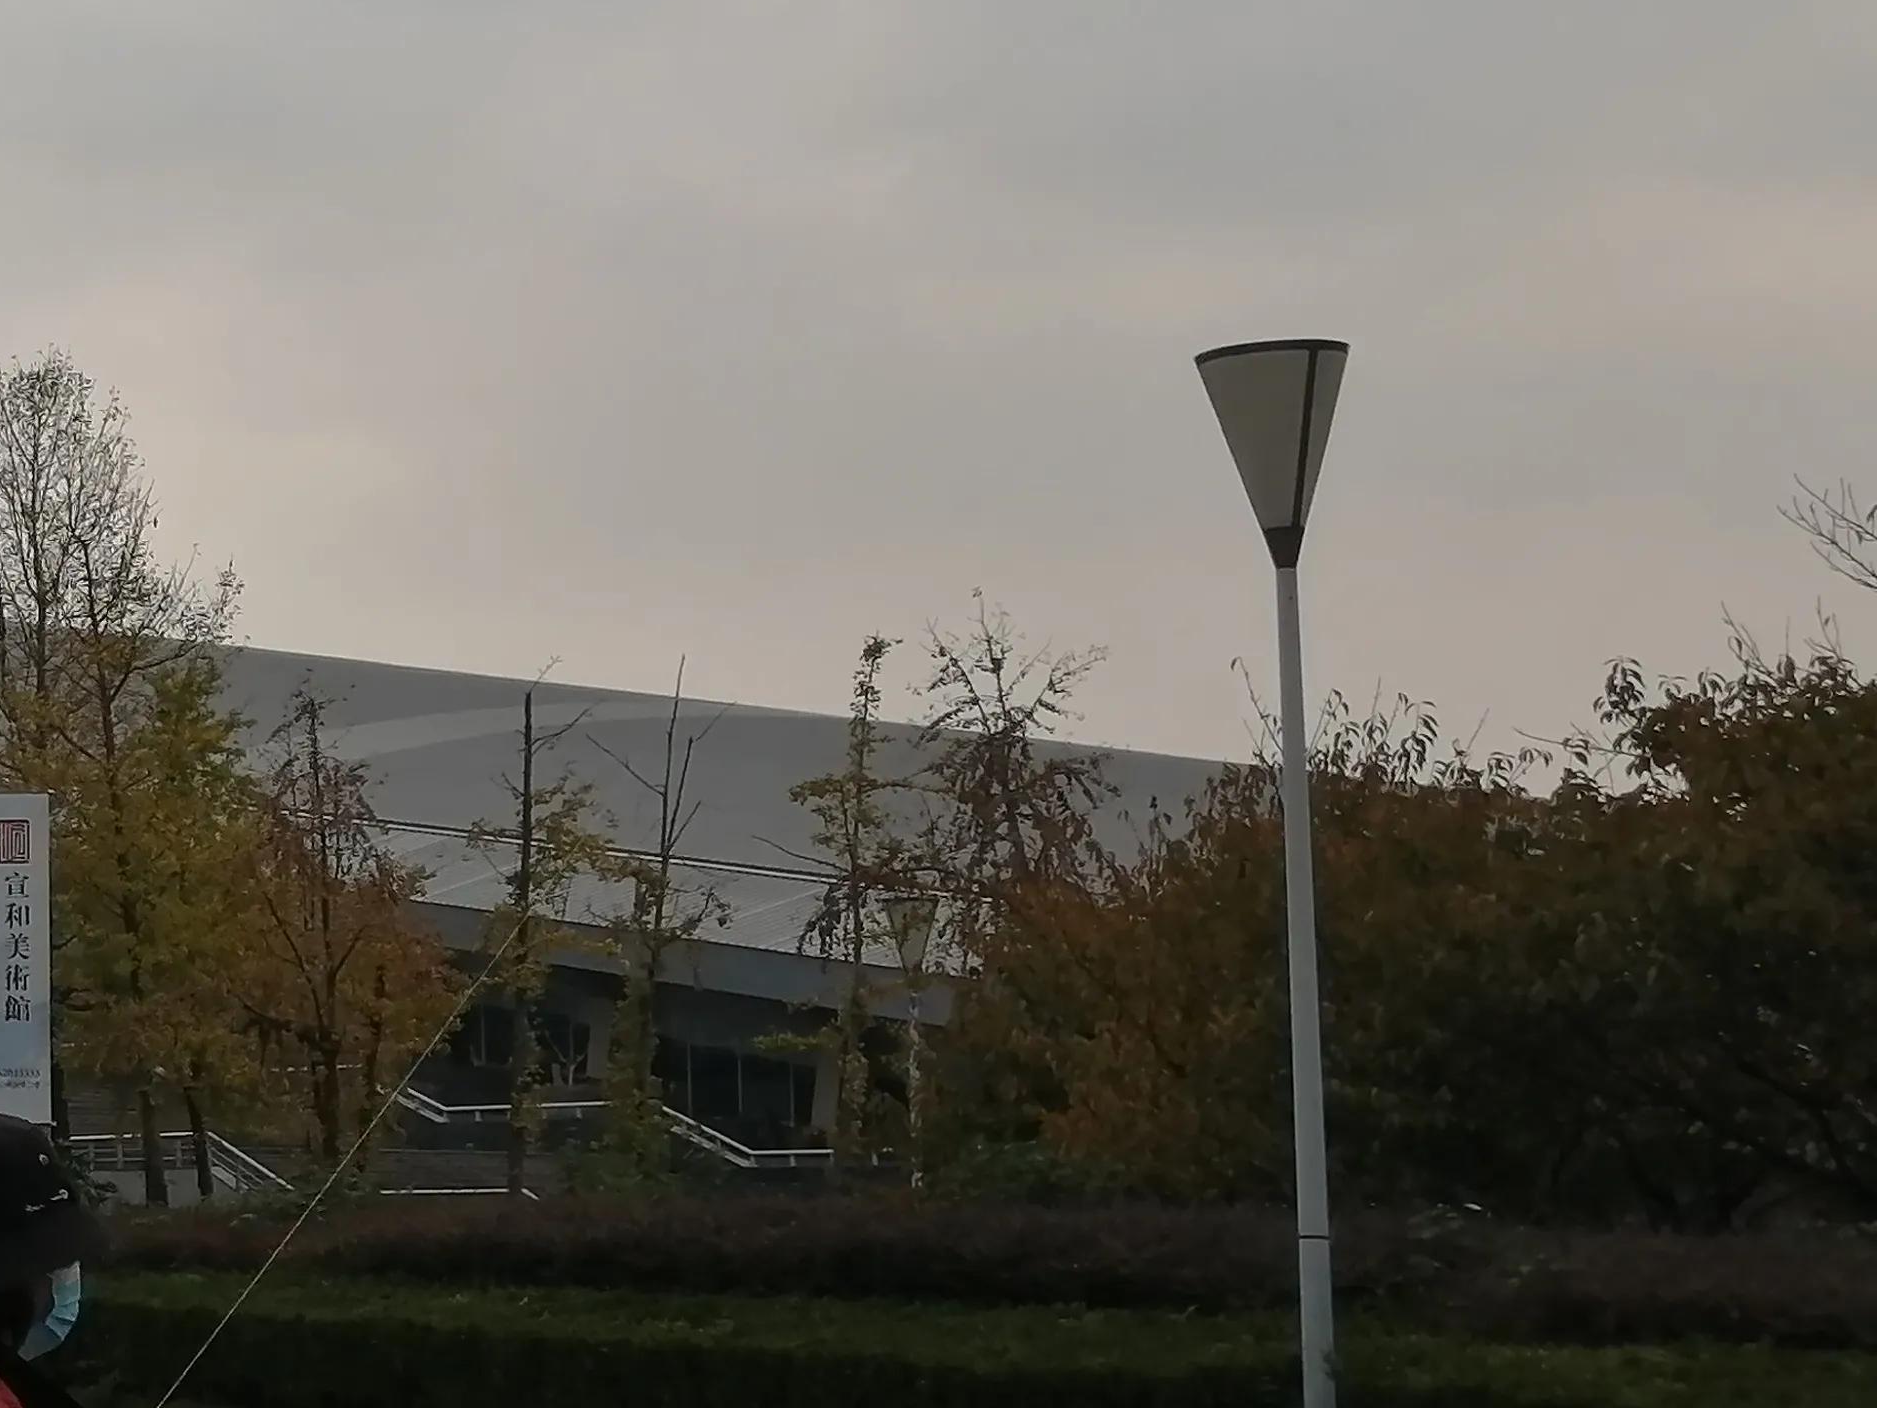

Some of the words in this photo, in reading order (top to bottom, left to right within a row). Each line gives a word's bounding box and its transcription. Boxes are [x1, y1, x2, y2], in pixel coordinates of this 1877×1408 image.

[4, 872, 31, 1023] 宣和美術館
